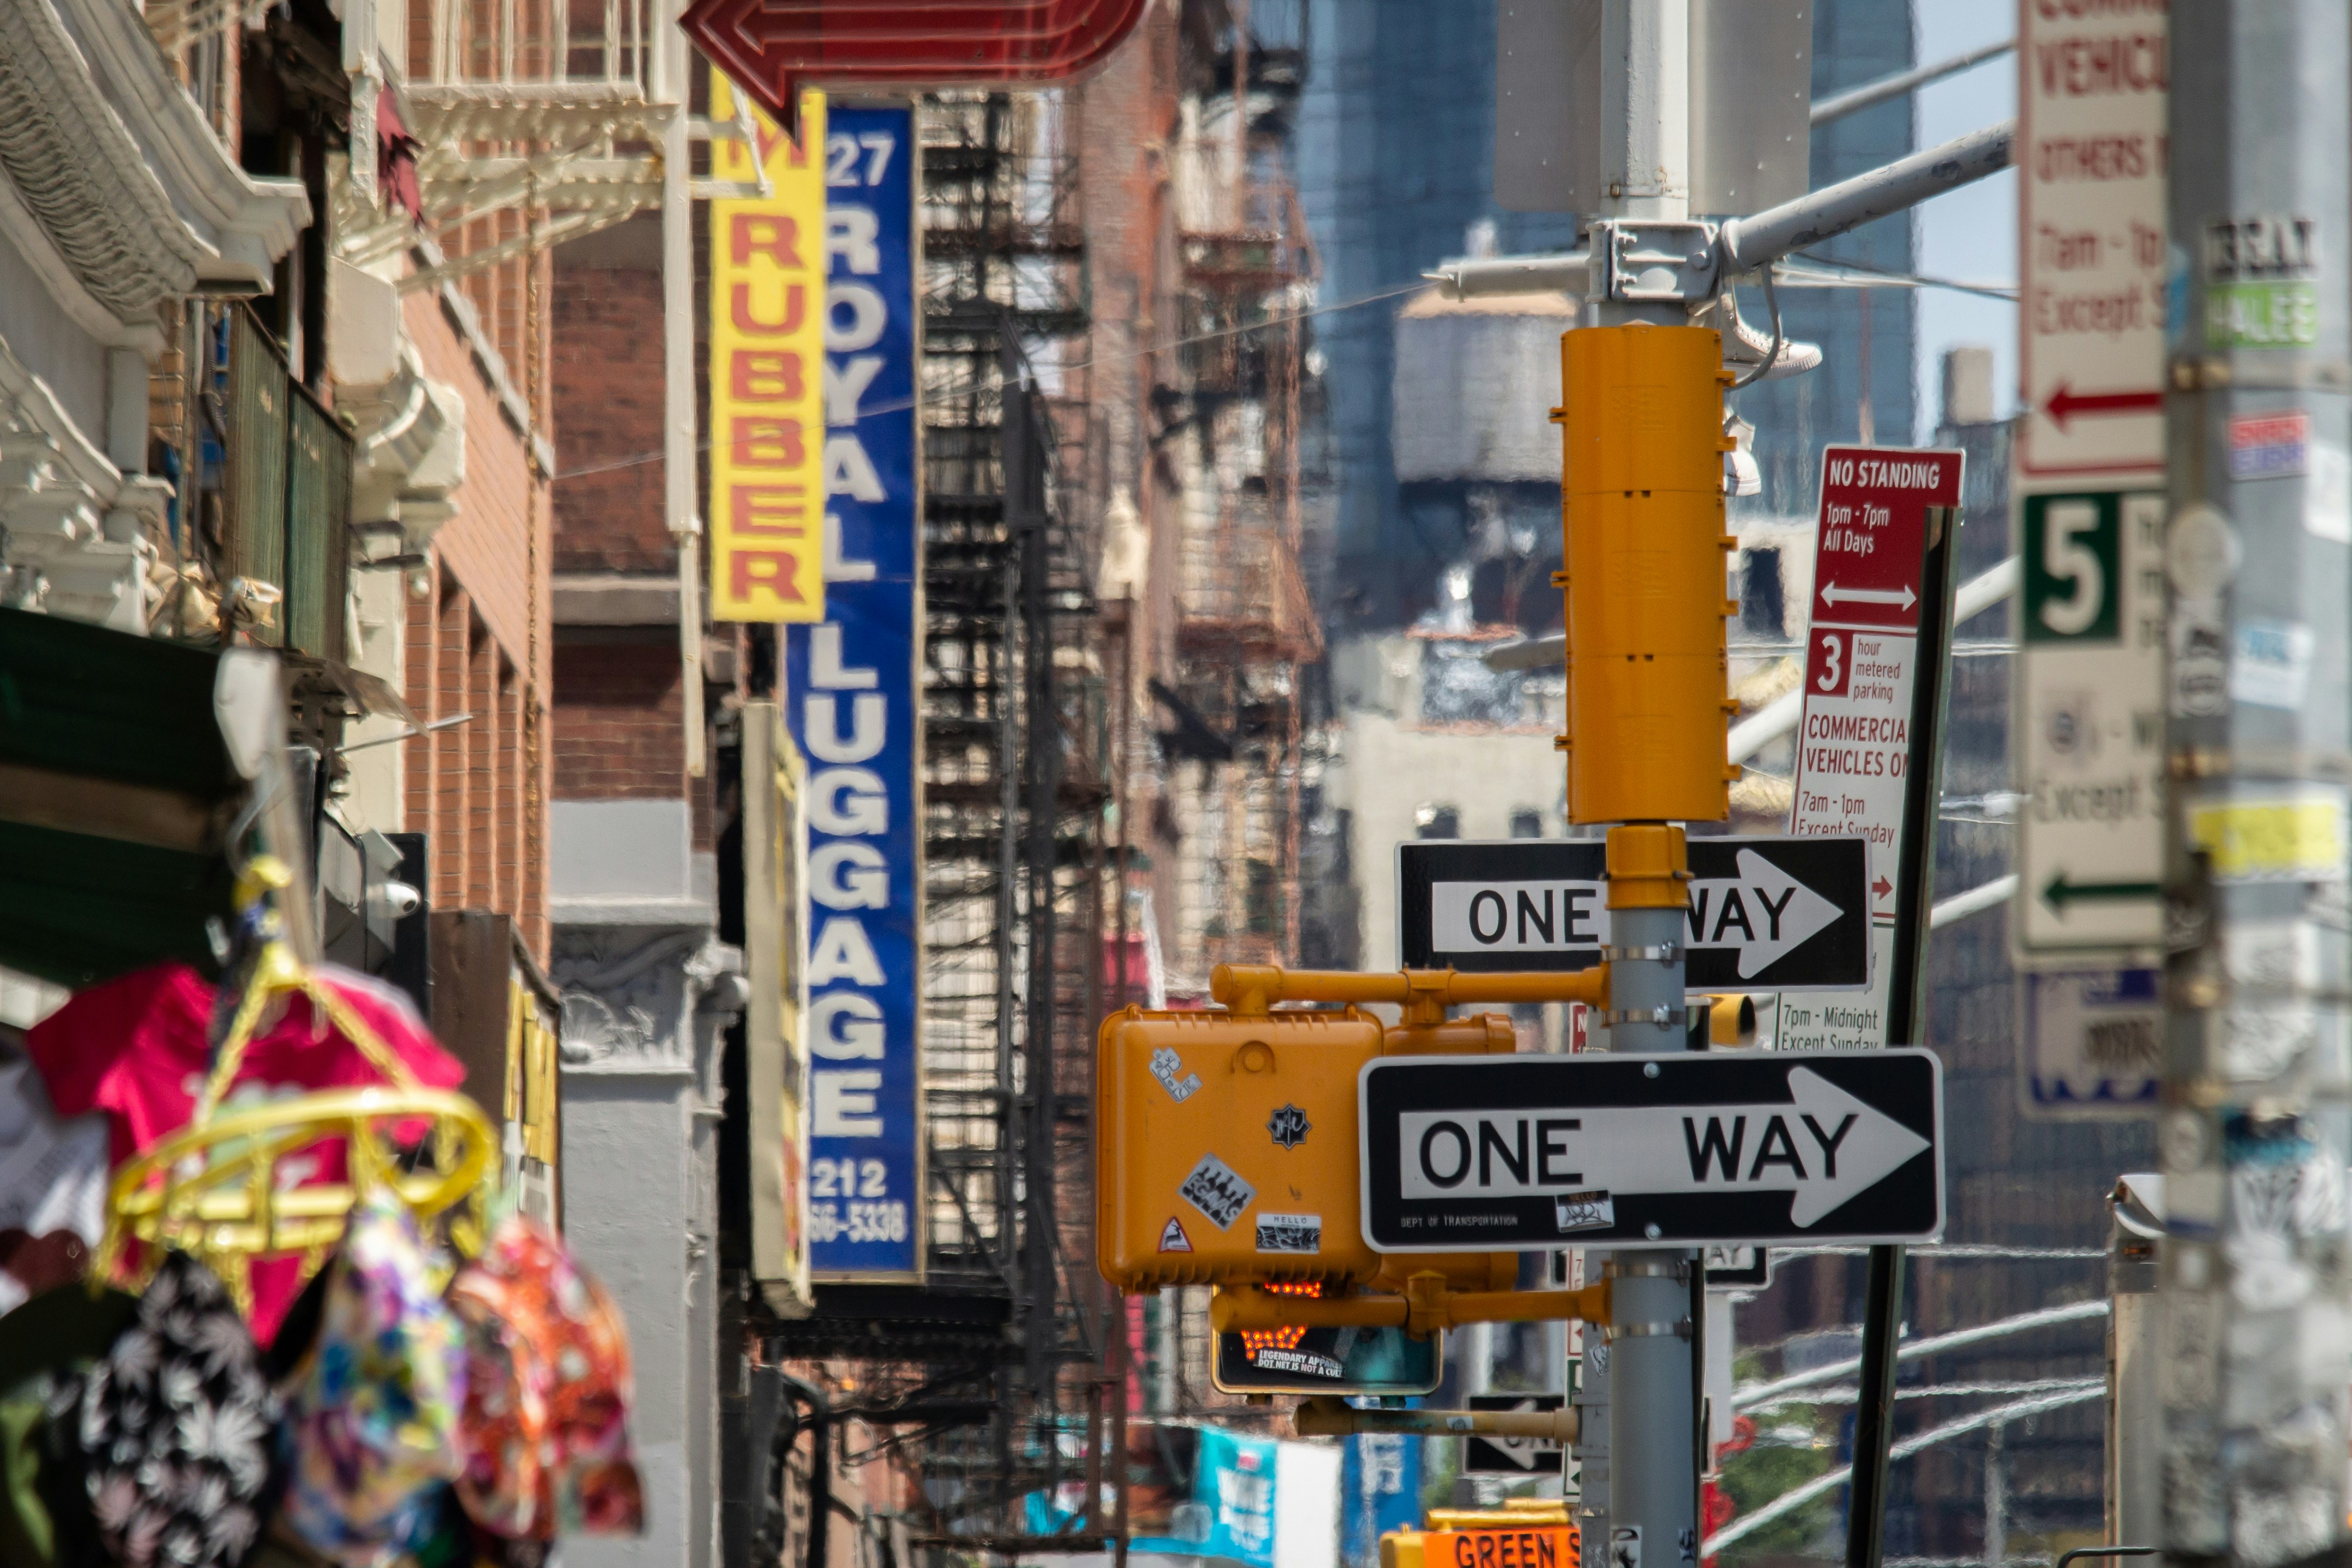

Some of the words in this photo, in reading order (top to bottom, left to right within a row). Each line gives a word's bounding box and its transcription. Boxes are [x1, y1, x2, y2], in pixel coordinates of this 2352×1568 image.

[727, 212, 808, 605] RUBBER
[823, 206, 889, 583] ROYAL
[1829, 458, 1854, 487] NO
[1857, 461, 1940, 489] STANDING
[1827, 501, 1851, 528] 1pm
[1863, 502, 1890, 530] 7pm
[1823, 528, 1841, 552] All
[1843, 529, 1875, 558] Days
[2039, 498, 2106, 636] 5
[1857, 638, 1881, 656] hour
[1817, 635, 1842, 691] 3
[1855, 662, 1901, 679] metered
[1853, 682, 1894, 705] parking
[1808, 714, 1907, 744] COMMERCIA
[1806, 748, 1884, 777] VEHICLES
[1802, 791, 1828, 812] 7am
[1841, 793, 1865, 819] 1pm
[1848, 822, 1895, 848] Sunday
[804, 621, 890, 1138] LUGGAGE
[1468, 889, 1598, 945] ONE
[1784, 1004, 1811, 1031] 7pm
[1824, 1006, 1878, 1033] Midnight
[1419, 1119, 1583, 1189] ONE
[1682, 1114, 1859, 1183] WAY
[811, 1158, 887, 1198] 212
[1273, 1216, 1307, 1224] HELLO
[1400, 1217, 1423, 1228] DEPT
[1443, 1214, 1518, 1227] TRANSPORTATION
[1258, 1358, 1274, 1368] DOT
[1276, 1361, 1290, 1369] NET
[1292, 1362, 1299, 1371] IS
[1301, 1364, 1316, 1374] NOT
[1326, 1368, 1343, 1377] CULT
[1259, 1349, 1307, 1363] LEGENDARY
[1455, 1533, 1555, 1568] GREEN
